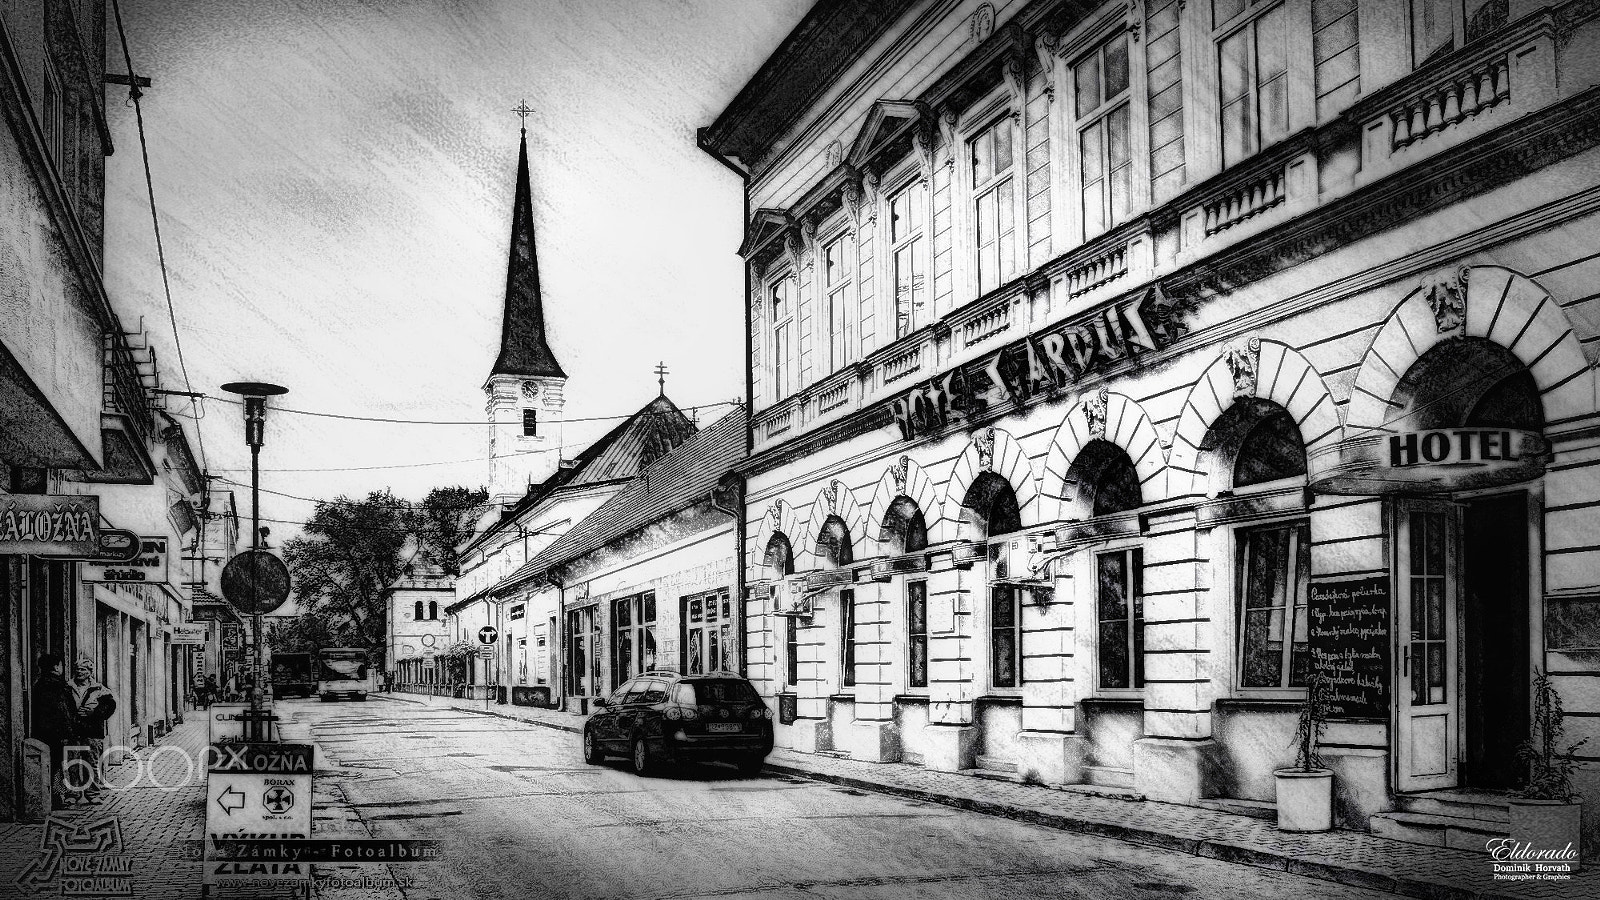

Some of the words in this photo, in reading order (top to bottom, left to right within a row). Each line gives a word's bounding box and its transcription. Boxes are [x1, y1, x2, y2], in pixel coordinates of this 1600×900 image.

[1389, 430, 1520, 468] HOTEL
[0, 501, 96, 542] ÁLOŽŇA
[263, 778, 295, 786] BORAX
